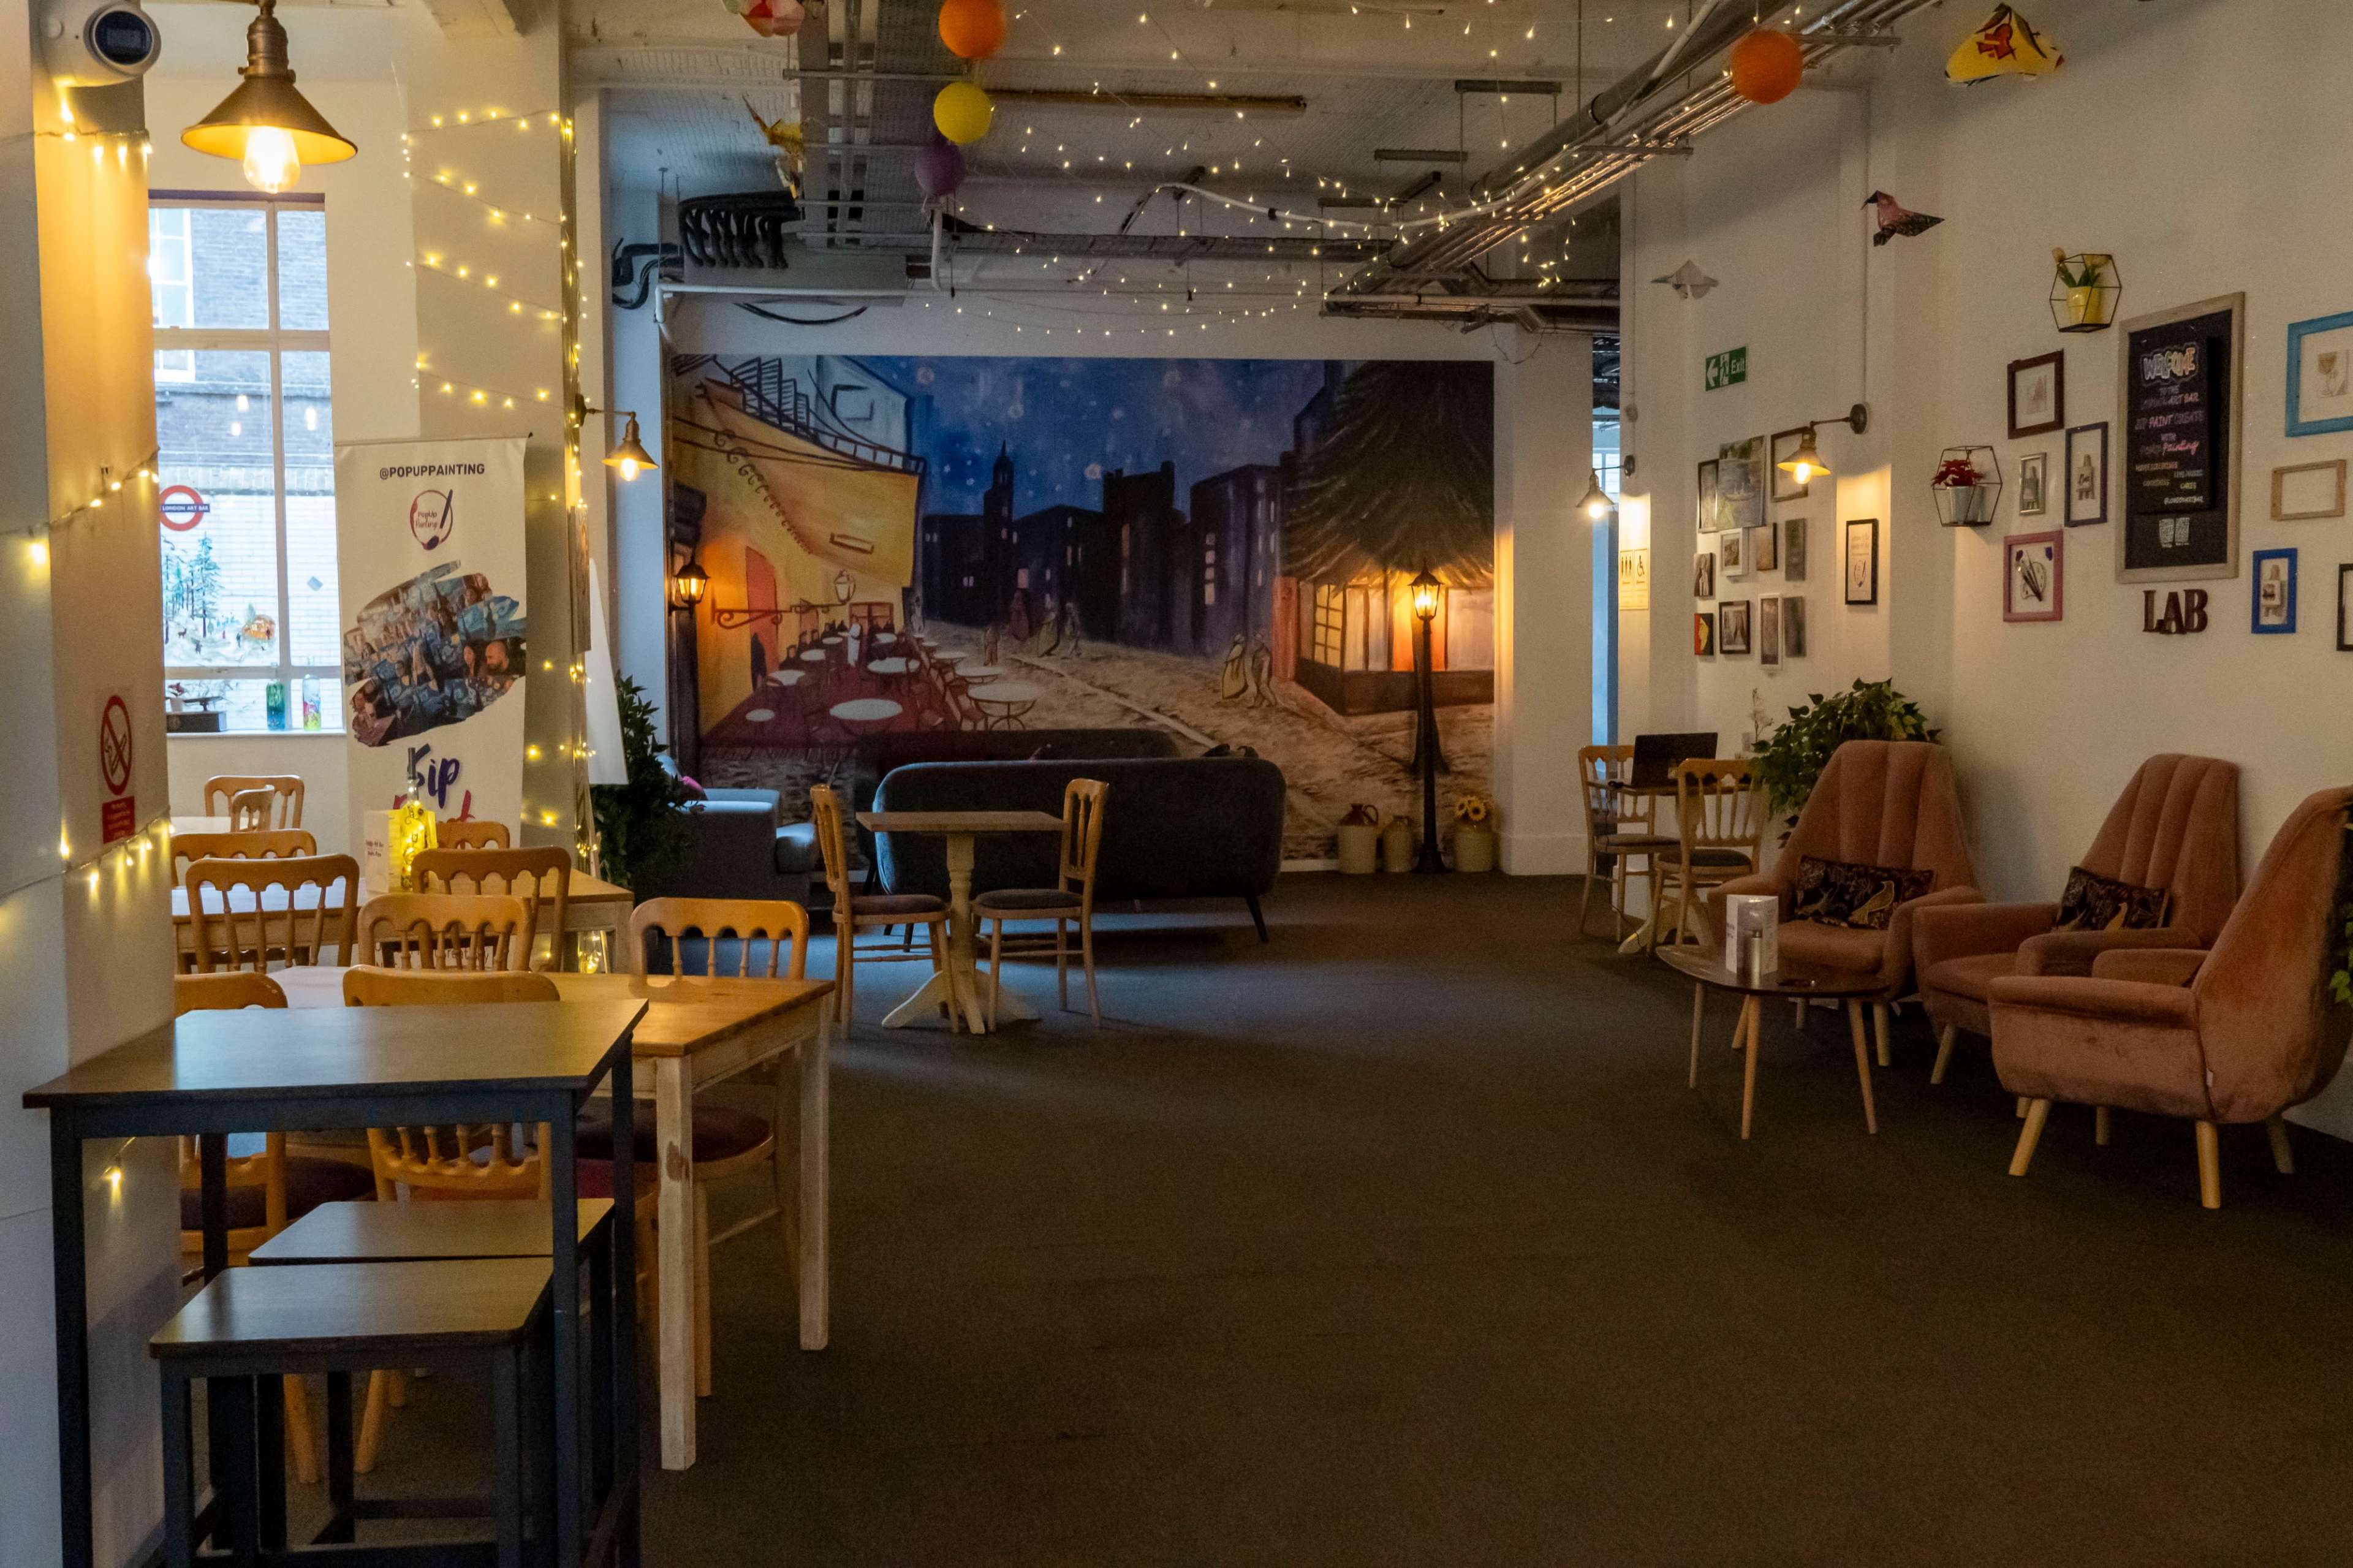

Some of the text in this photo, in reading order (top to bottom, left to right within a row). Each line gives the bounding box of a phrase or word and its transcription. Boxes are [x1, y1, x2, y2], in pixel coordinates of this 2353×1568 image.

[1731, 357, 1746, 374] Exit
[2143, 347, 2196, 380] WELCOME
[2168, 393, 2184, 404] ART
[2183, 392, 2199, 403] BAR
[2148, 414, 2174, 429] PAINT
[379, 463, 485, 480] @POPUPPAINTING
[418, 510, 438, 521] PopUp
[2142, 589, 2208, 635] LAB
